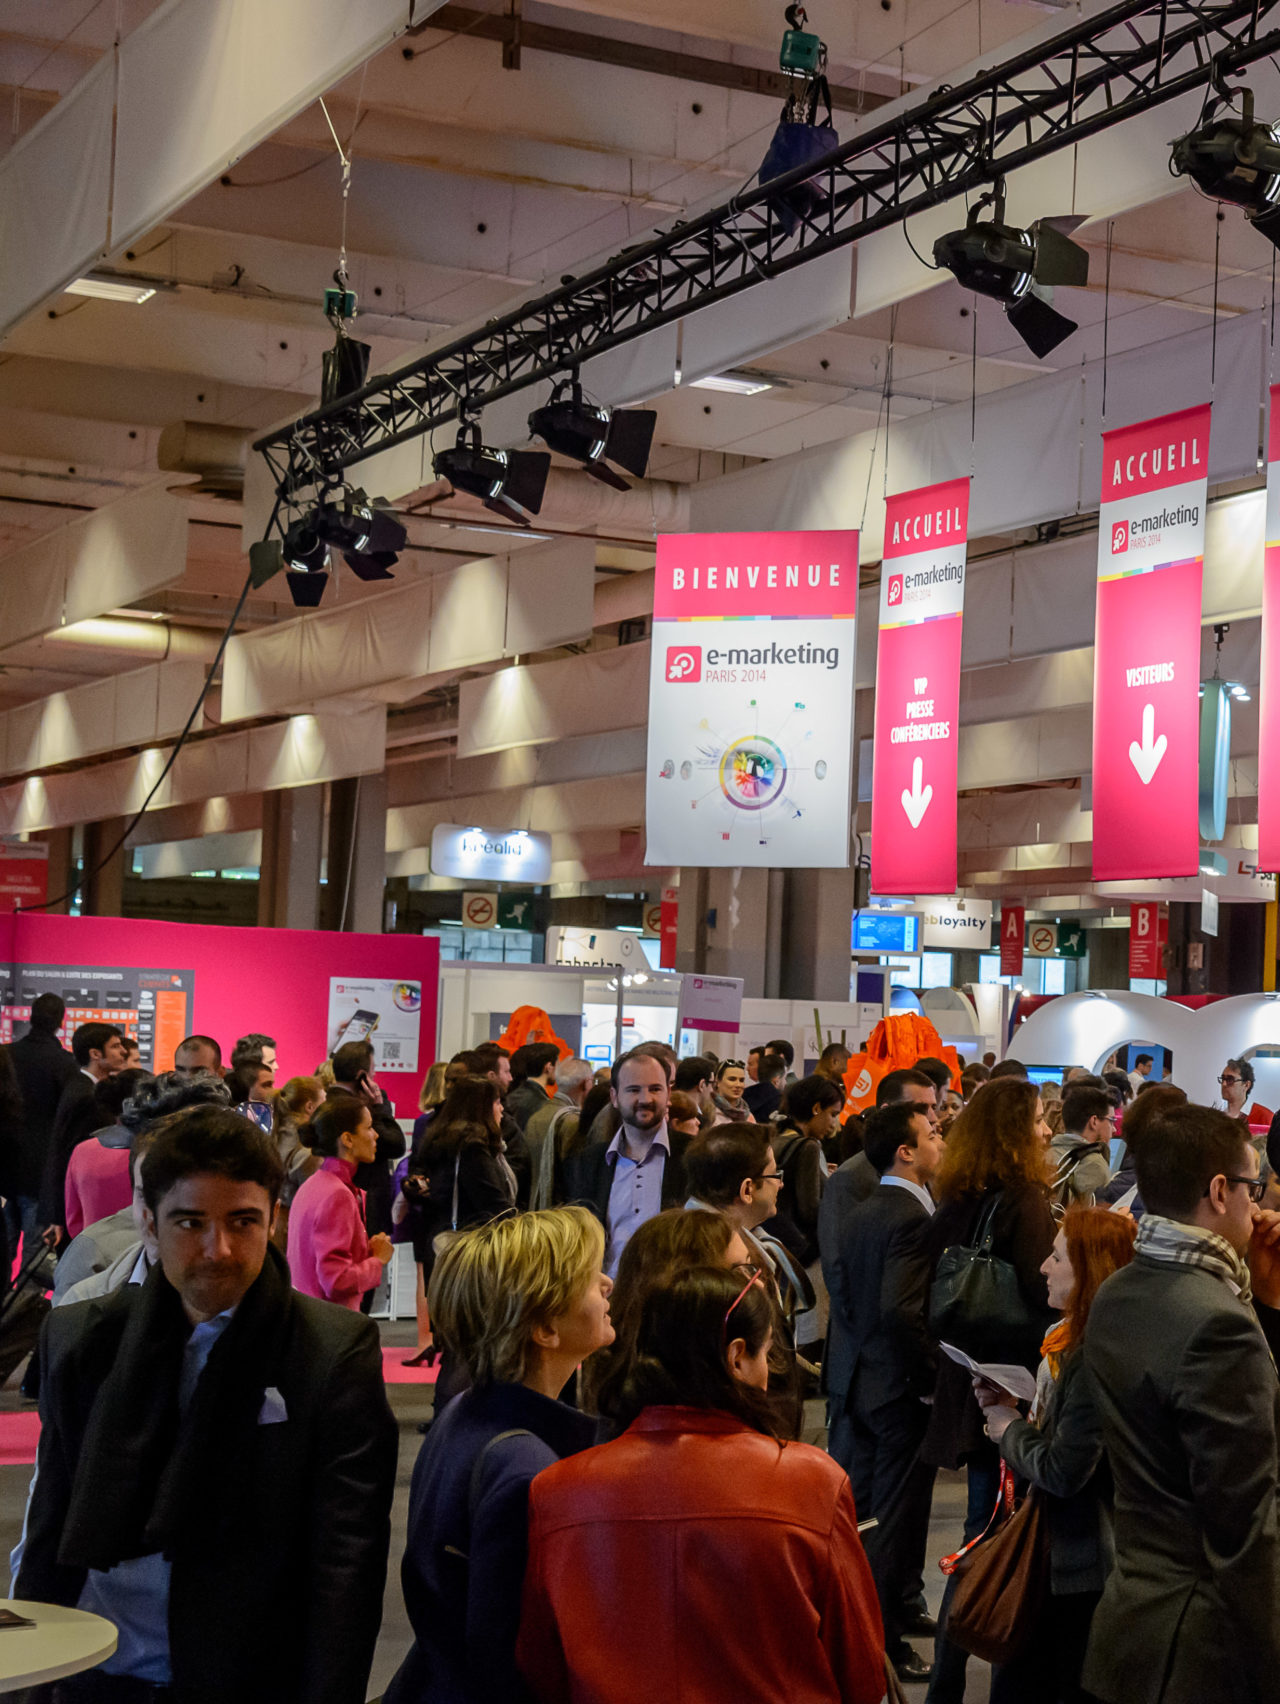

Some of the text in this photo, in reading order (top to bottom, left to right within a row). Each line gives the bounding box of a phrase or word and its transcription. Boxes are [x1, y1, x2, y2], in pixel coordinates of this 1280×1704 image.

[1113, 438, 1199, 486] ACCUEIL
[893, 507, 961, 545] ACCUEIL
[1130, 505, 1199, 535] e-marketing
[1130, 533, 1161, 550] PARIS 2014
[673, 564, 840, 590] BIENVENUE
[905, 562, 963, 589] e-marketing
[707, 642, 839, 669] e-marketing
[706, 669, 766, 683] PARIS 2014
[914, 677, 928, 695] VIP
[1126, 662, 1174, 688] VISITEURS
[906, 699, 934, 719] PRESSE
[891, 721, 950, 744] CONFÉRENCIERS
[1006, 912, 1018, 938] A
[1138, 908, 1149, 936] B
